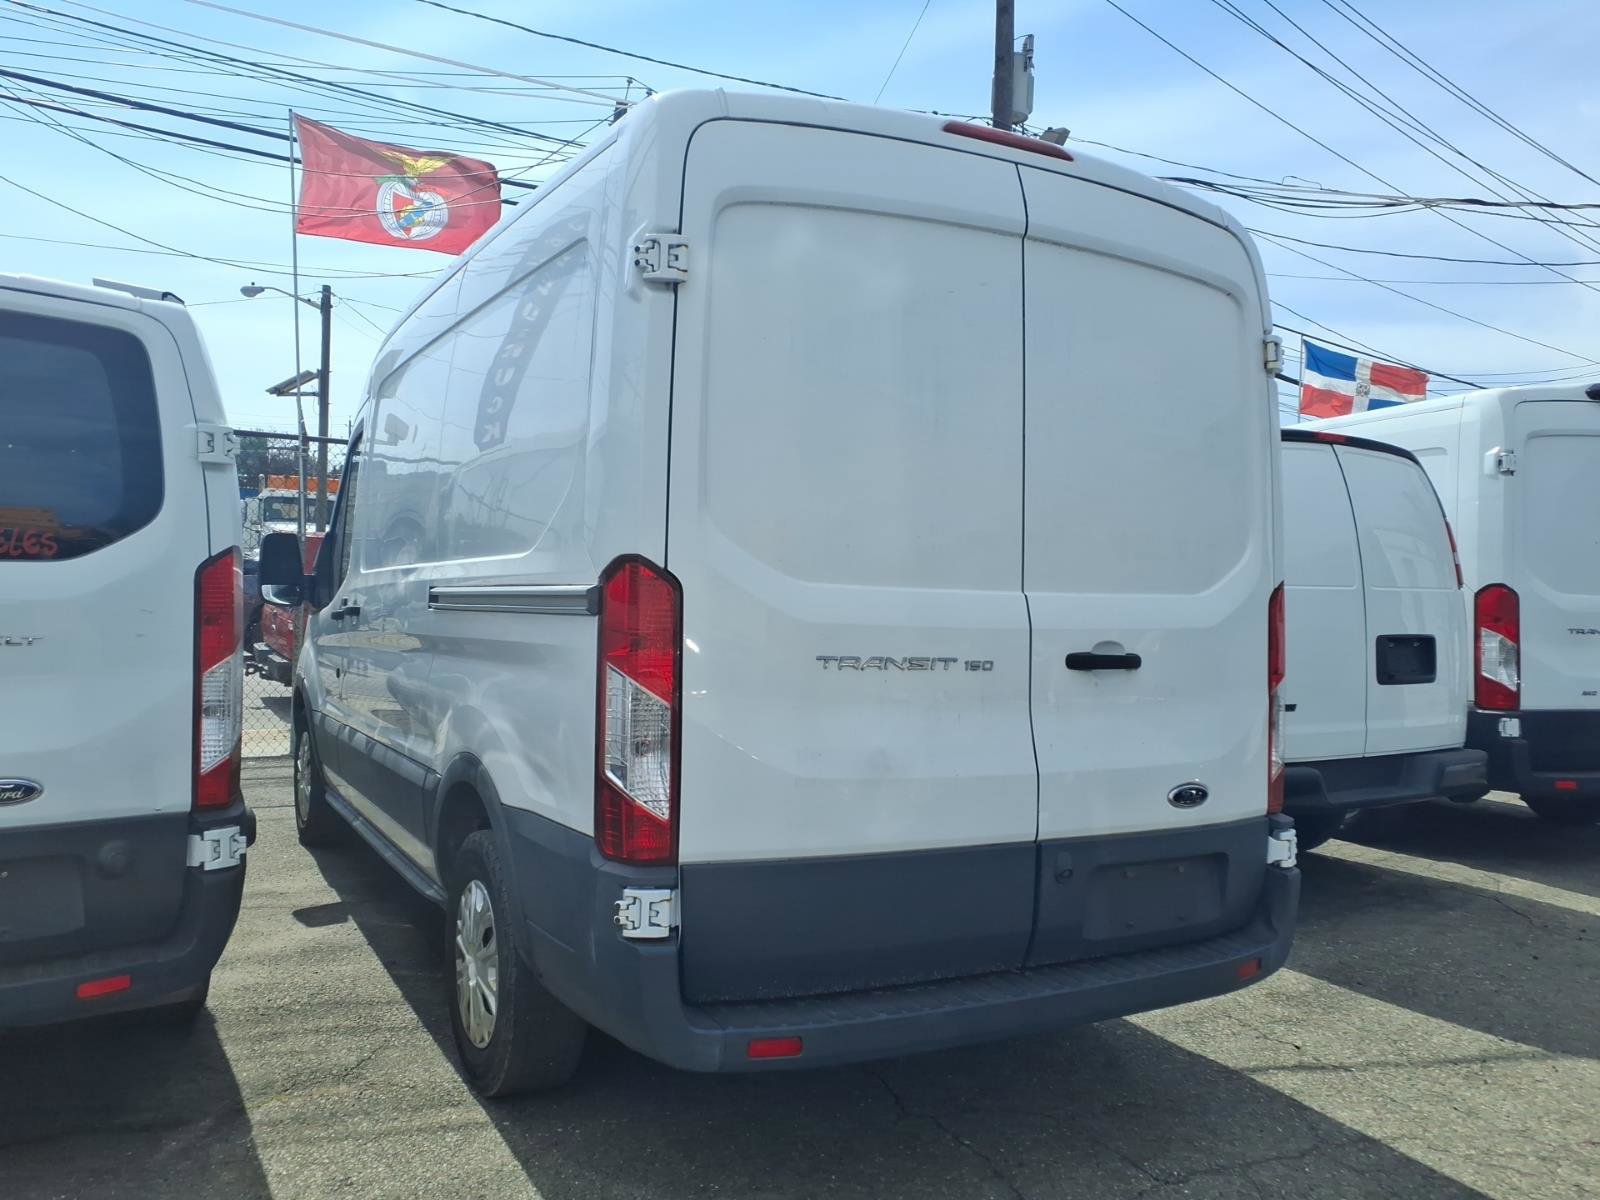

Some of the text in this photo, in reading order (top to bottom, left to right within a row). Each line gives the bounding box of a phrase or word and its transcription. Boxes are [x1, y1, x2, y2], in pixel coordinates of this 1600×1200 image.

[0, 636, 44, 646] LT
[816, 656, 994, 671] TRANSIT 150
